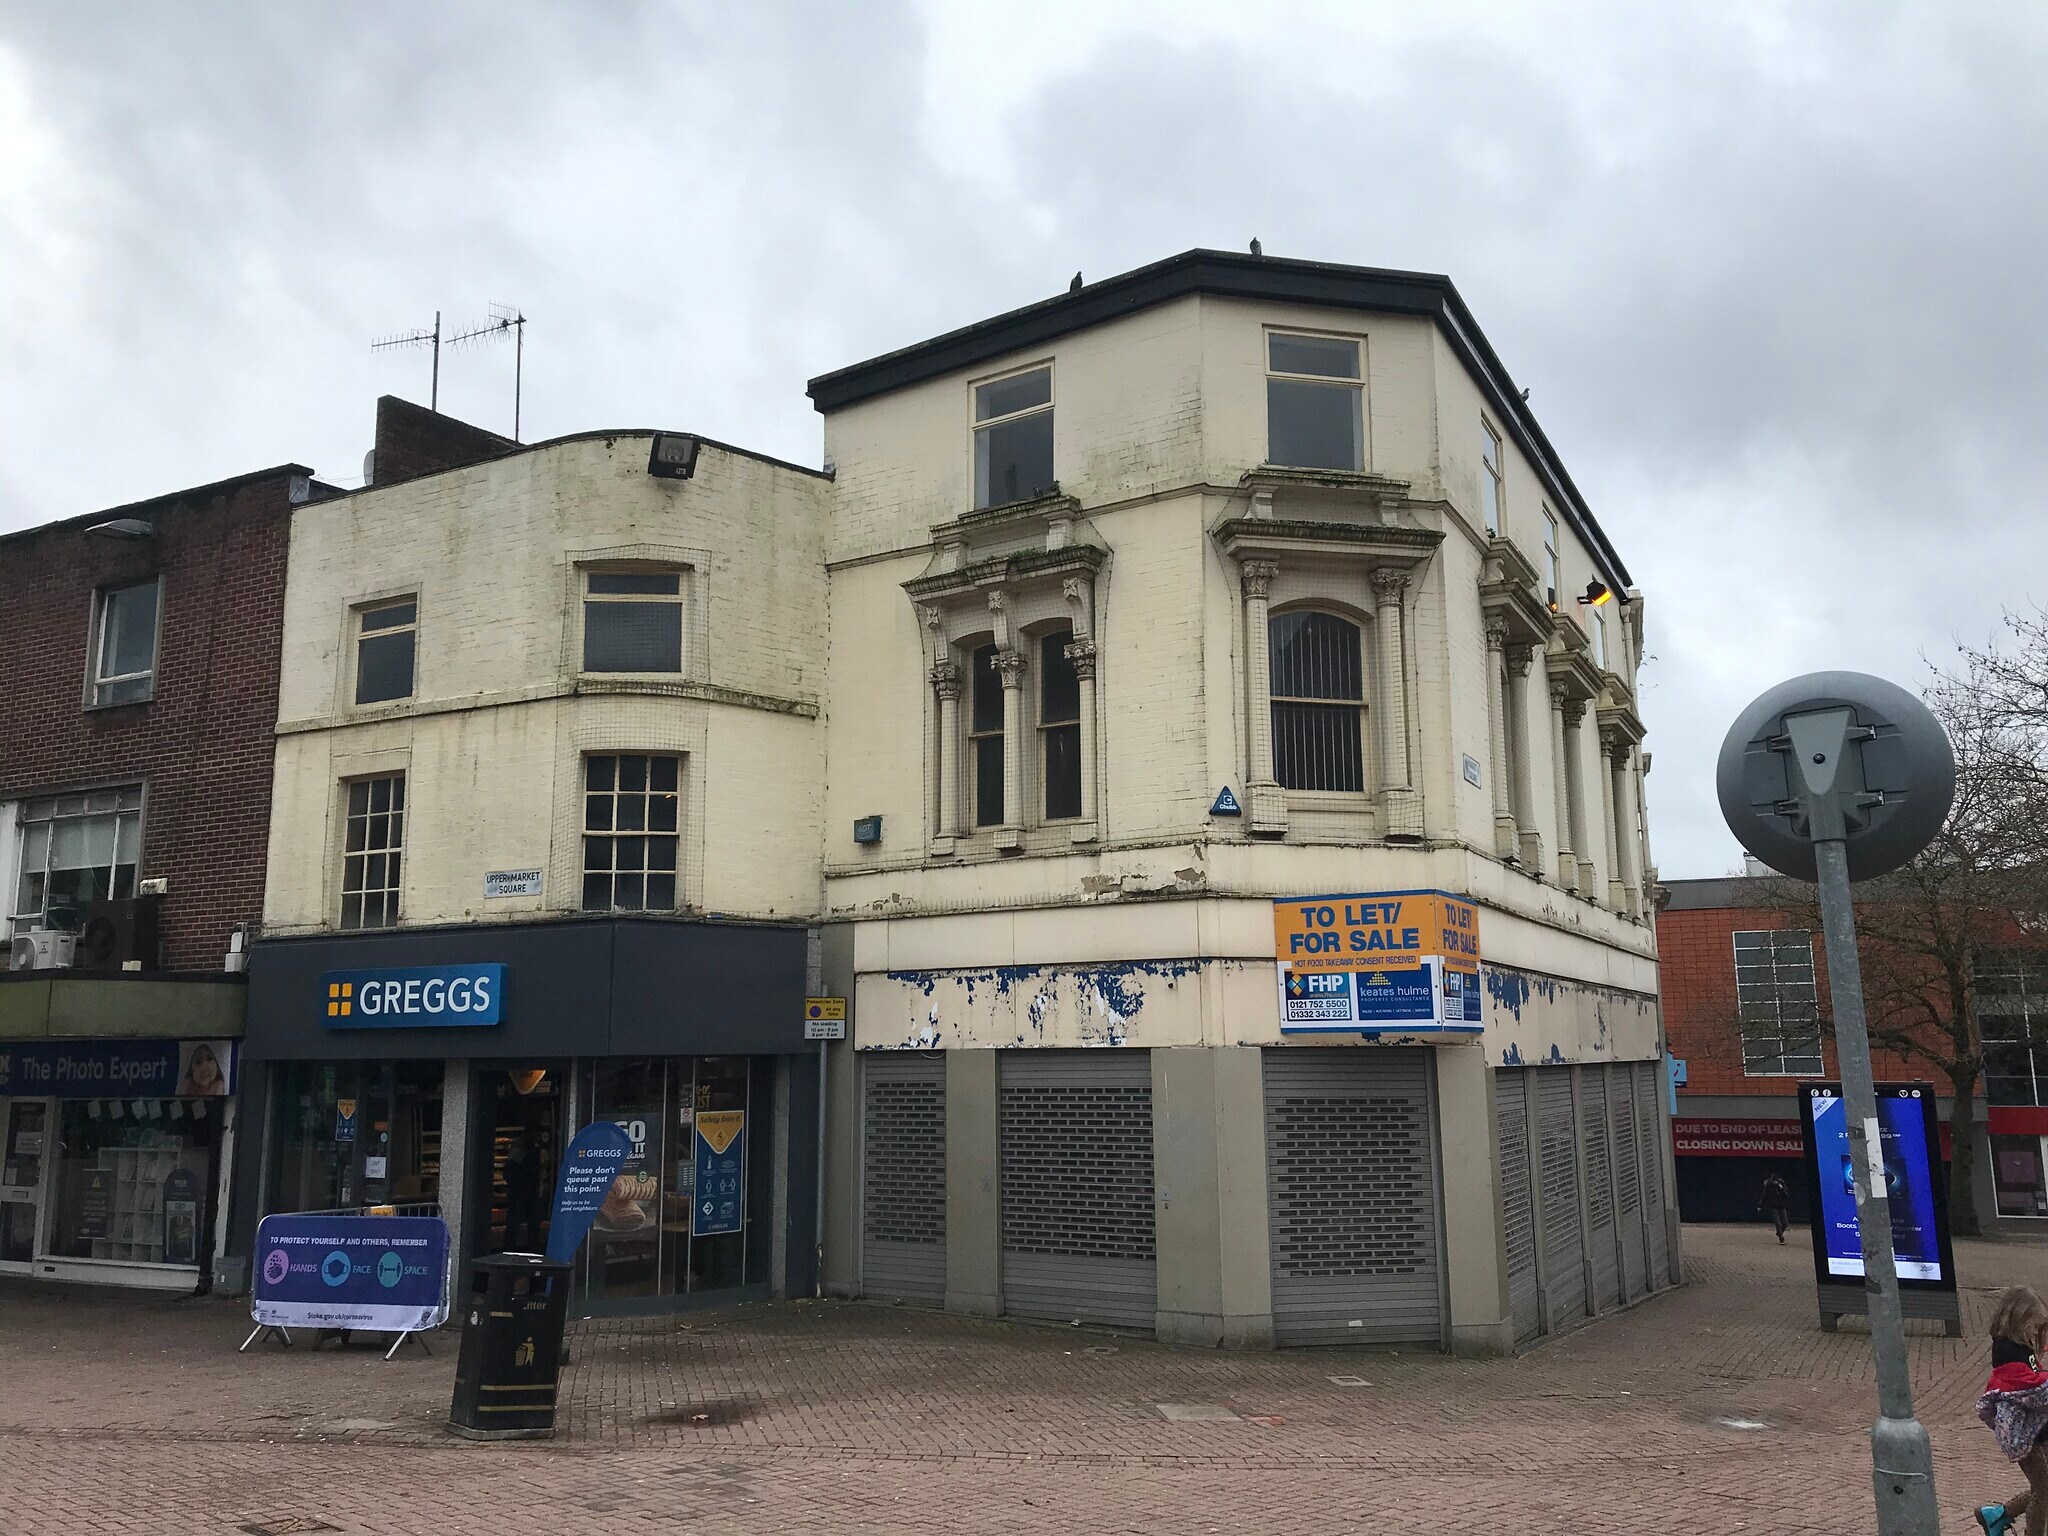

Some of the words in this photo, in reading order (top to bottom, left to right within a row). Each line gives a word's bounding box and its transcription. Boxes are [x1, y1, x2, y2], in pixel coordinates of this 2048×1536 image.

[486, 874, 508, 884] UPPER
[510, 872, 540, 882] MARKET
[499, 884, 527, 894] SQUARE
[1300, 906, 1336, 928] TO
[1345, 902, 1402, 926] LET/
[1445, 903, 1456, 926] TO
[1290, 932, 1340, 954] FOR
[1350, 928, 1420, 952] SALE
[1442, 928, 1458, 951] FOR
[1460, 932, 1477, 956] SALE
[1294, 960, 1306, 968] HOT
[1308, 959, 1324, 967] FOOD
[1325, 958, 1354, 967] TAKEAWAY
[1356, 956, 1384, 965] CONSENT
[1386, 955, 1416, 964] RECEIVED
[1308, 974, 1344, 992] FHP
[360, 976, 490, 1015] GREGGS
[1360, 987, 1395, 997] keates
[1398, 986, 1430, 996] hulme
[1290, 1001, 1307, 1009] 0121
[1310, 1000, 1324, 1008] 752
[1326, 1000, 1348, 1008] 5500
[1290, 1010, 1314, 1018] 01332
[22, 1056, 50, 1080] The
[56, 1056, 104, 1081] Photo
[110, 1056, 168, 1086] Expert
[1814, 1098, 1828, 1112] NEW
[1676, 1124, 1700, 1134] DUE
[1702, 1124, 1718, 1134] TO
[1721, 1124, 1746, 1134] END
[1748, 1125, 1765, 1134] OF
[1676, 1140, 1730, 1150] CLOSING
[1732, 1140, 1774, 1150] DOWN
[586, 1150, 621, 1158] GREGGS
[569, 1166, 592, 1174] Please
[595, 1166, 615, 1174] don't
[566, 1176, 589, 1184] queue
[591, 1176, 608, 1184] past
[564, 1185, 578, 1193] this
[579, 1185, 601, 1194] point.
[311, 1237, 345, 1245] YOURSELF
[362, 1238, 390, 1247] OTHERS,
[290, 1264, 318, 1273] HANDS
[353, 1265, 372, 1274] FACE
[404, 1266, 428, 1275] SPACE
[522, 1301, 547, 1310] itter
[307, 1312, 373, 1322] Stoke.gov.uk/coronavirus
